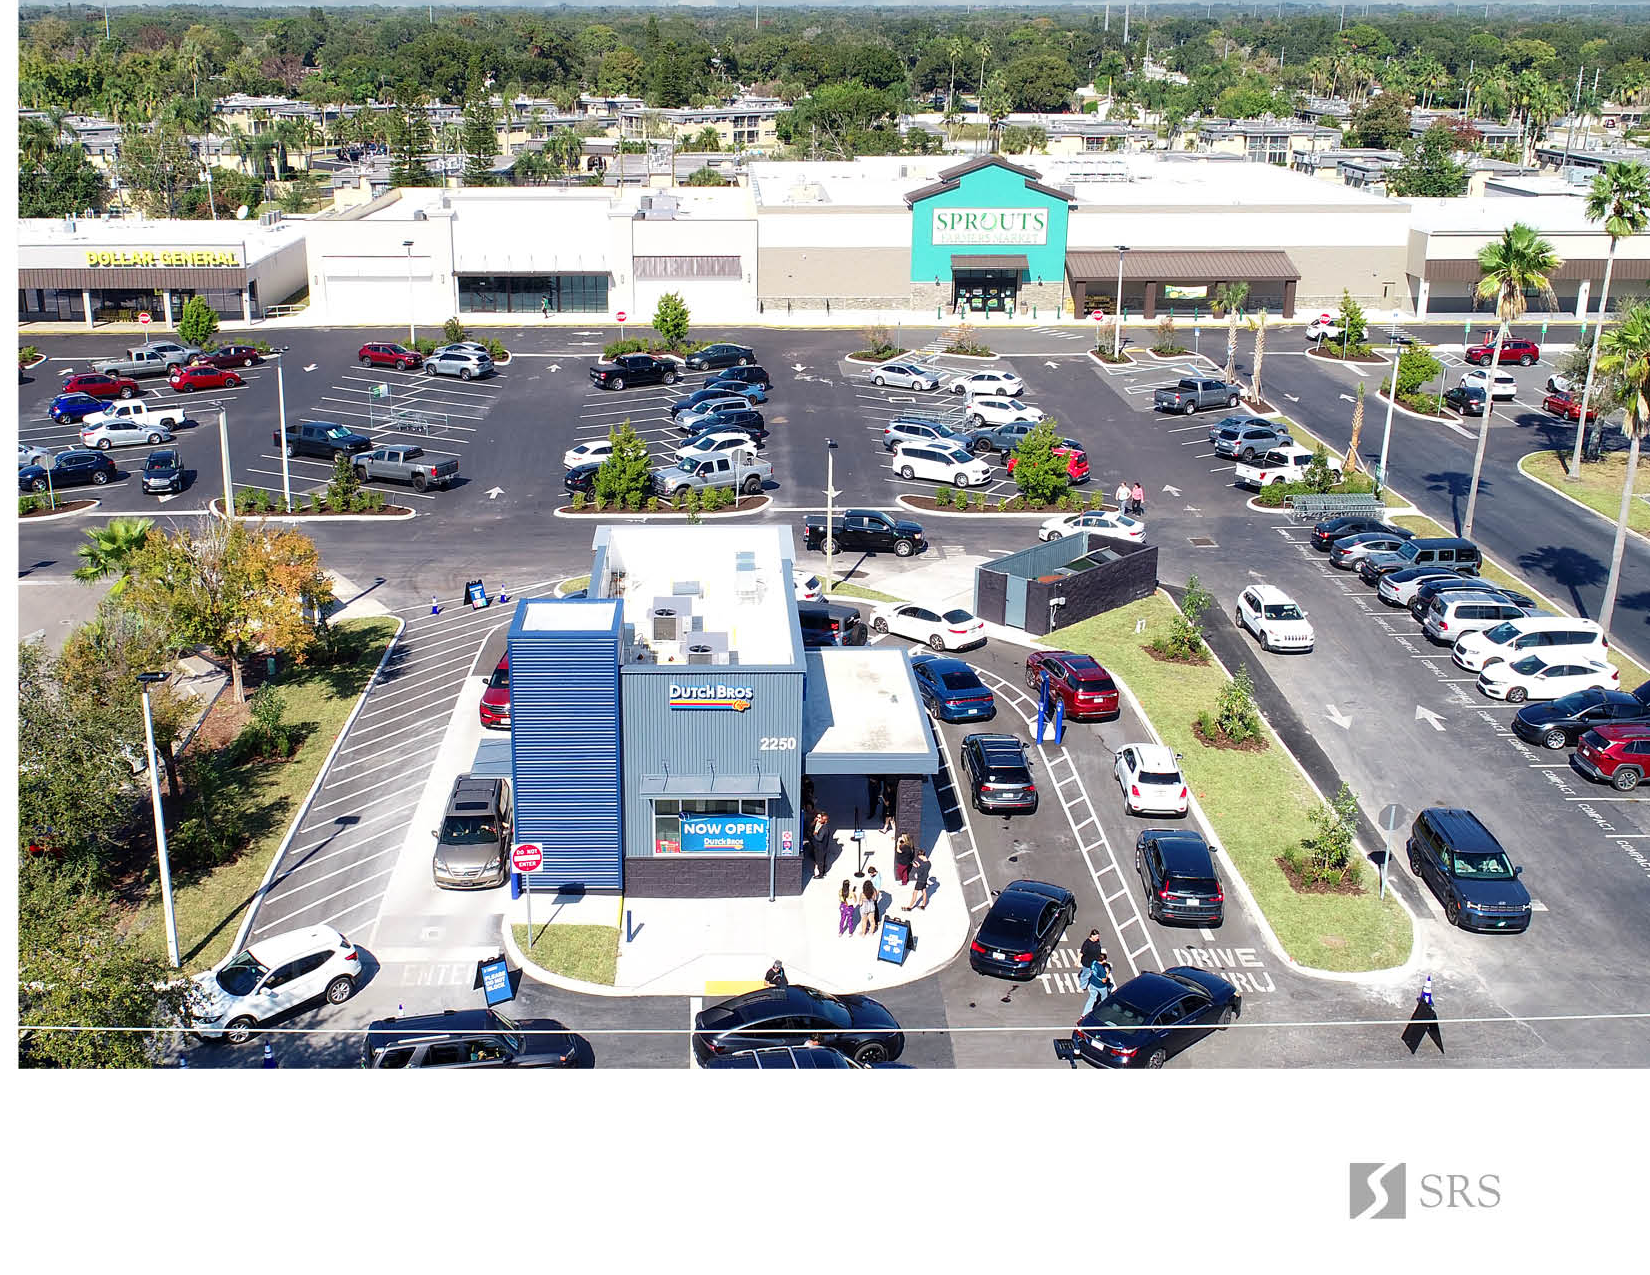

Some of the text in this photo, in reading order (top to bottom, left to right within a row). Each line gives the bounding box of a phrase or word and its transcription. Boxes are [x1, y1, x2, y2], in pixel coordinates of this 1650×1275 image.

[936, 212, 1045, 231] SPROUTS
[86, 250, 240, 267] DOLLAR GENERAL
[717, 685, 753, 699] BROS
[759, 737, 797, 751] 2250
[1541, 769, 1577, 795] COMPACT
[1577, 803, 1616, 832] COMPACT
[684, 823, 764, 835] NOW OPEN
[1173, 948, 1265, 968] DRIVE
